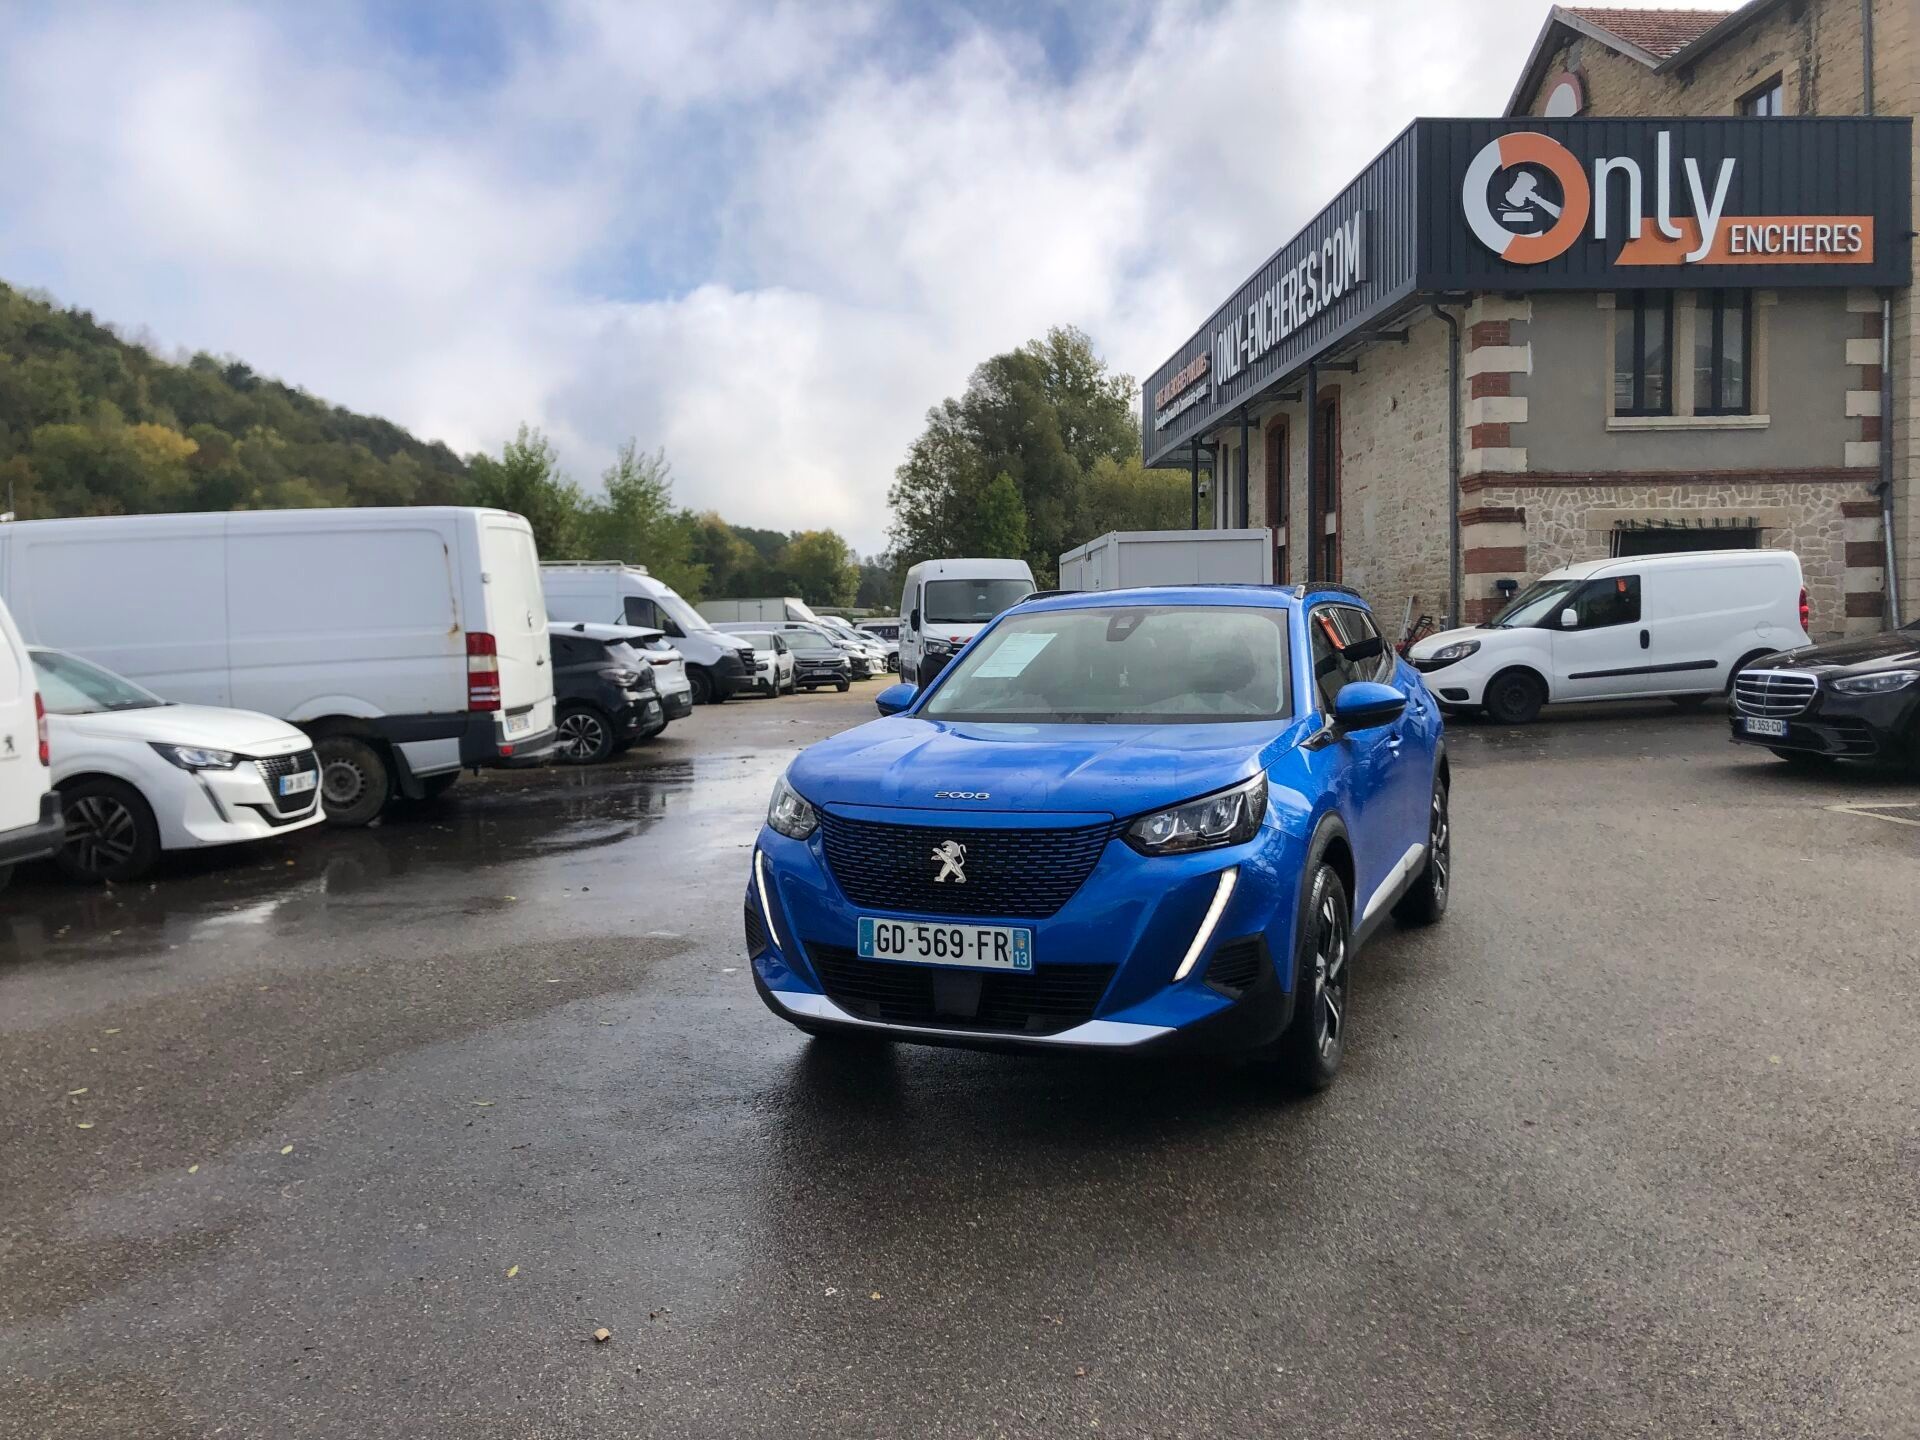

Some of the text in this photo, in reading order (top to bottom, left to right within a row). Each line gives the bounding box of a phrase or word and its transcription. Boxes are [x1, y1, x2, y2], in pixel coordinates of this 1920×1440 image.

[1463, 131, 1736, 263] Only
[1731, 224, 1862, 254] ENCHERES
[1217, 210, 1360, 386] ONLY-ENCHERES.COM
[934, 791, 990, 800] 2008
[864, 942, 869, 950] F
[876, 924, 1009, 962] GD-569-FR
[1014, 951, 1028, 966] 13
